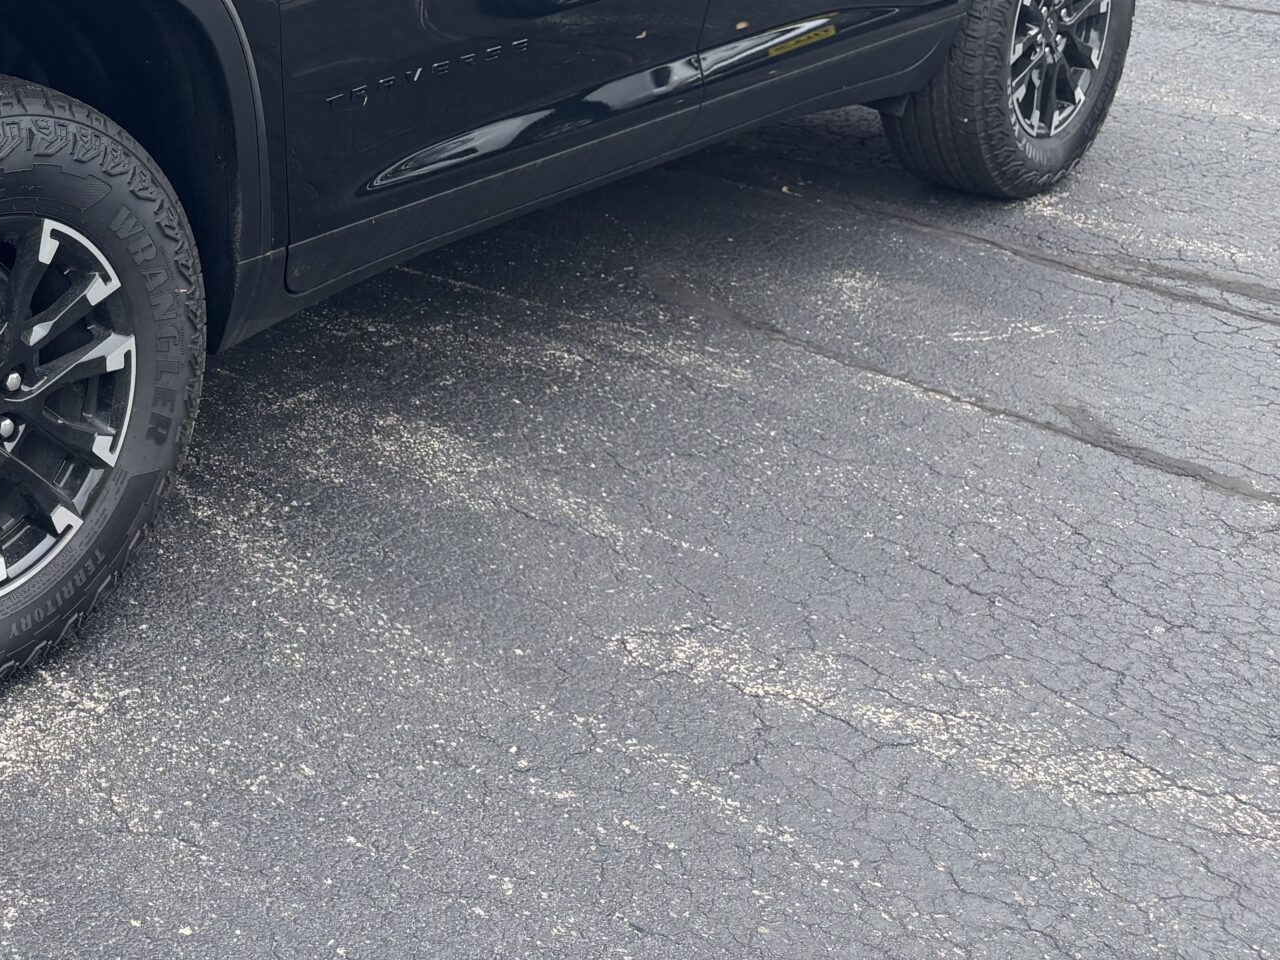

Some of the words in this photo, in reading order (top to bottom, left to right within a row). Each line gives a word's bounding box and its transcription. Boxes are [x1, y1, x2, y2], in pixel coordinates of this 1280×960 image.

[325, 38, 528, 111] TRAVERSE
[109, 204, 180, 446] WRANGLER
[5, 548, 108, 640] TERRITORY
